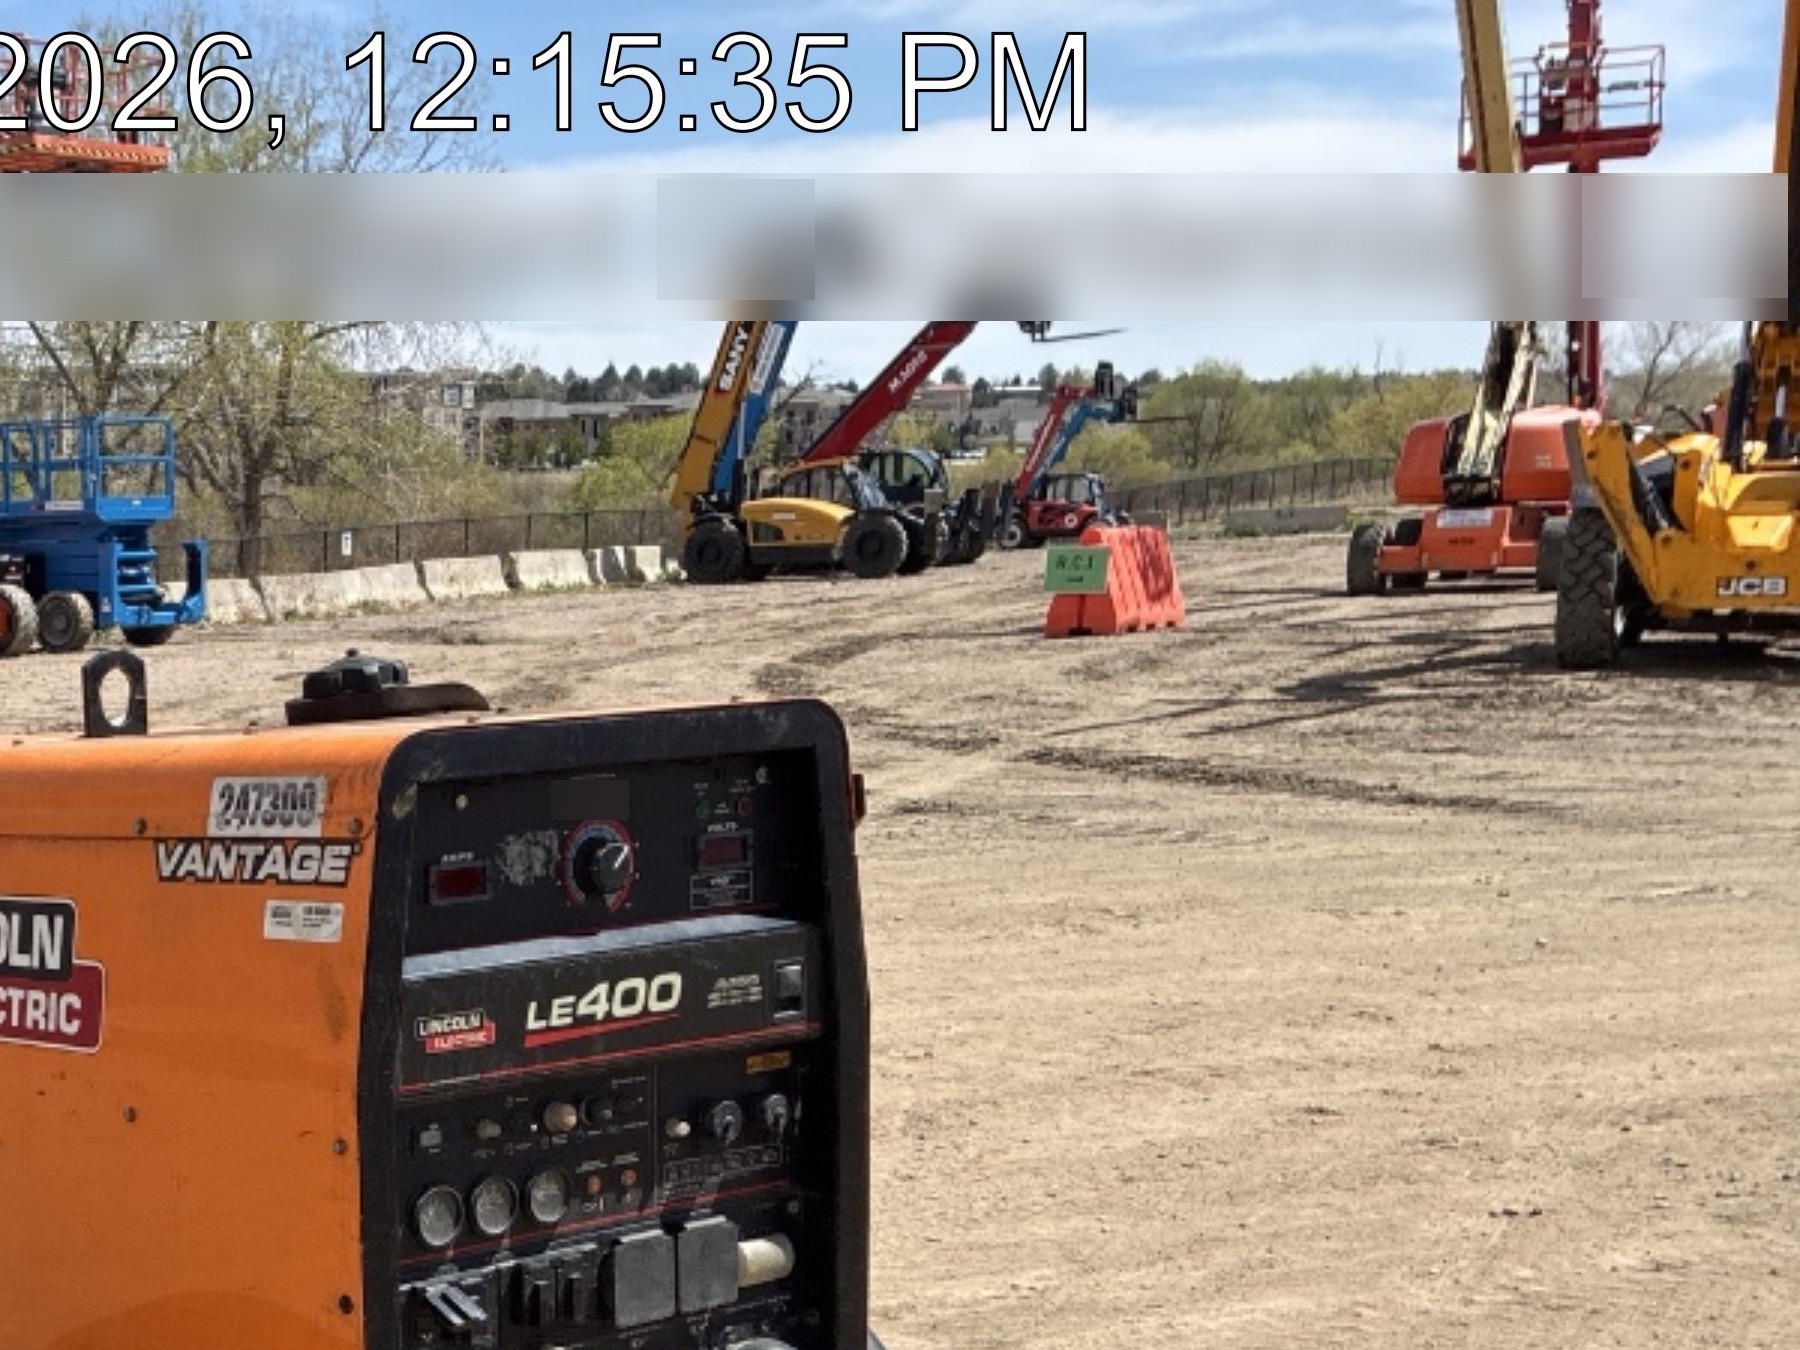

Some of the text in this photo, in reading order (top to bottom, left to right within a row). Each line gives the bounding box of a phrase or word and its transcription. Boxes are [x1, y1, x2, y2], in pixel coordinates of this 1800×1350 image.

[718, 325, 749, 391] SANY
[1718, 577, 1786, 595] JCB
[156, 842, 352, 884] VANTAGE
[526, 971, 683, 1031] LE400
[420, 1012, 480, 1036] LINCOLN
